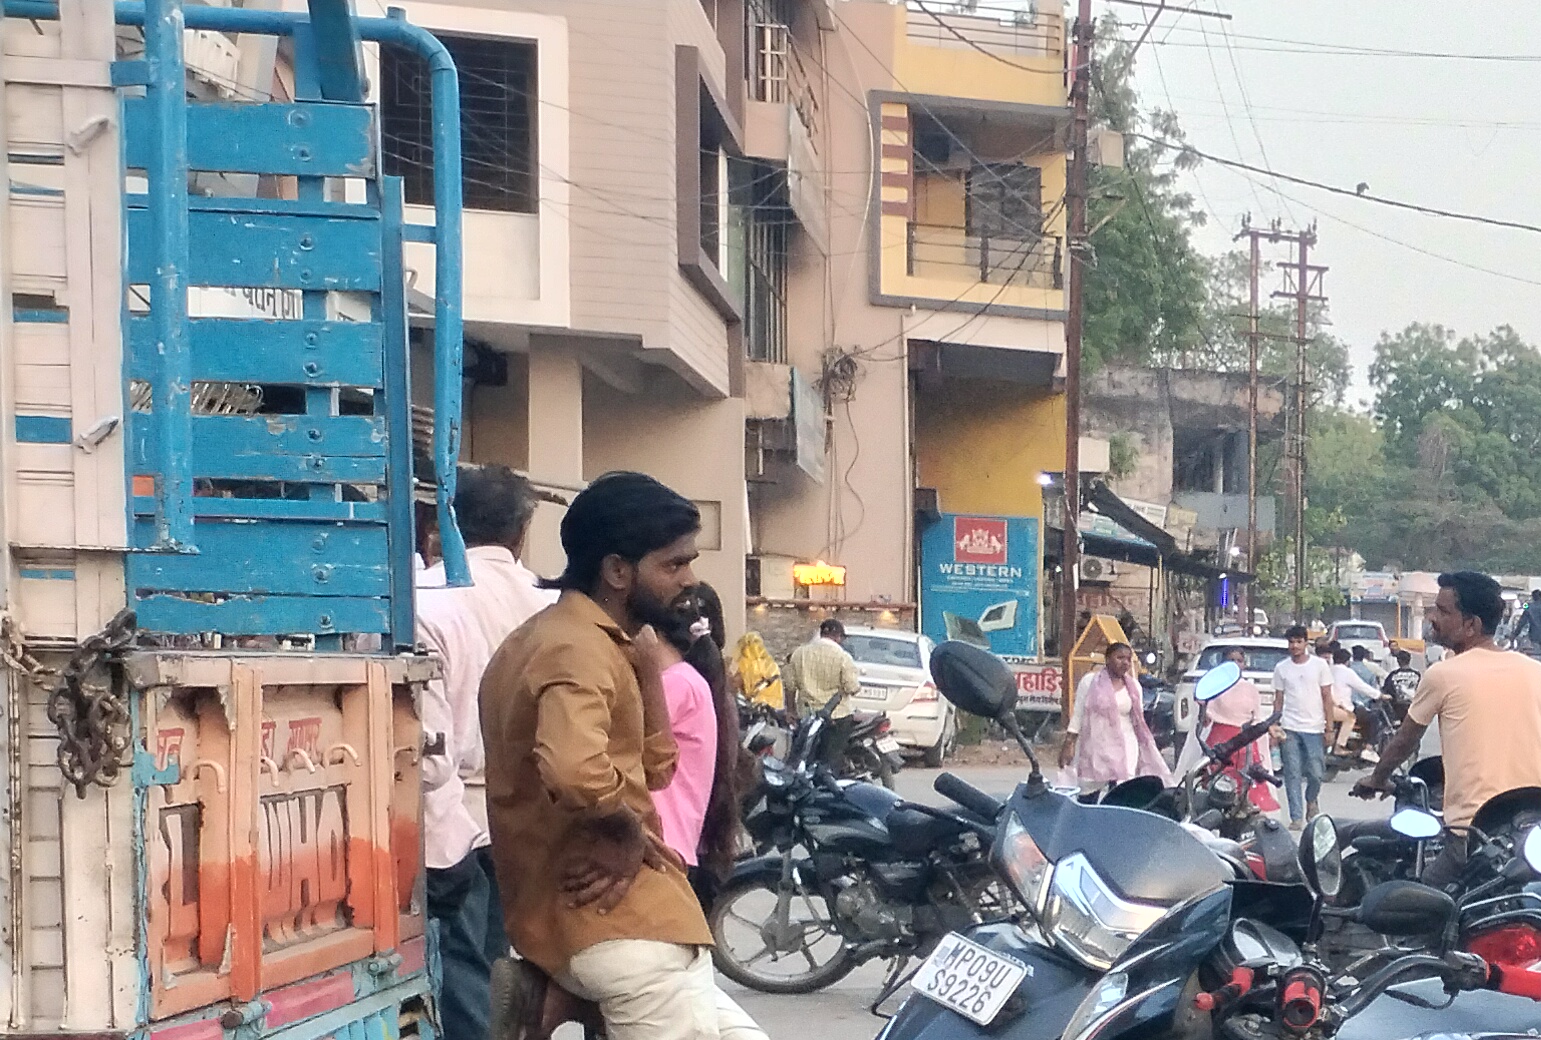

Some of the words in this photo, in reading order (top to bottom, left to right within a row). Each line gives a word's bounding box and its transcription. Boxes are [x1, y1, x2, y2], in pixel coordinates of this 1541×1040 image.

[939, 563, 1022, 578] WESTERN
[943, 941, 1013, 989] MP09U
[926, 968, 992, 1014] S9226
